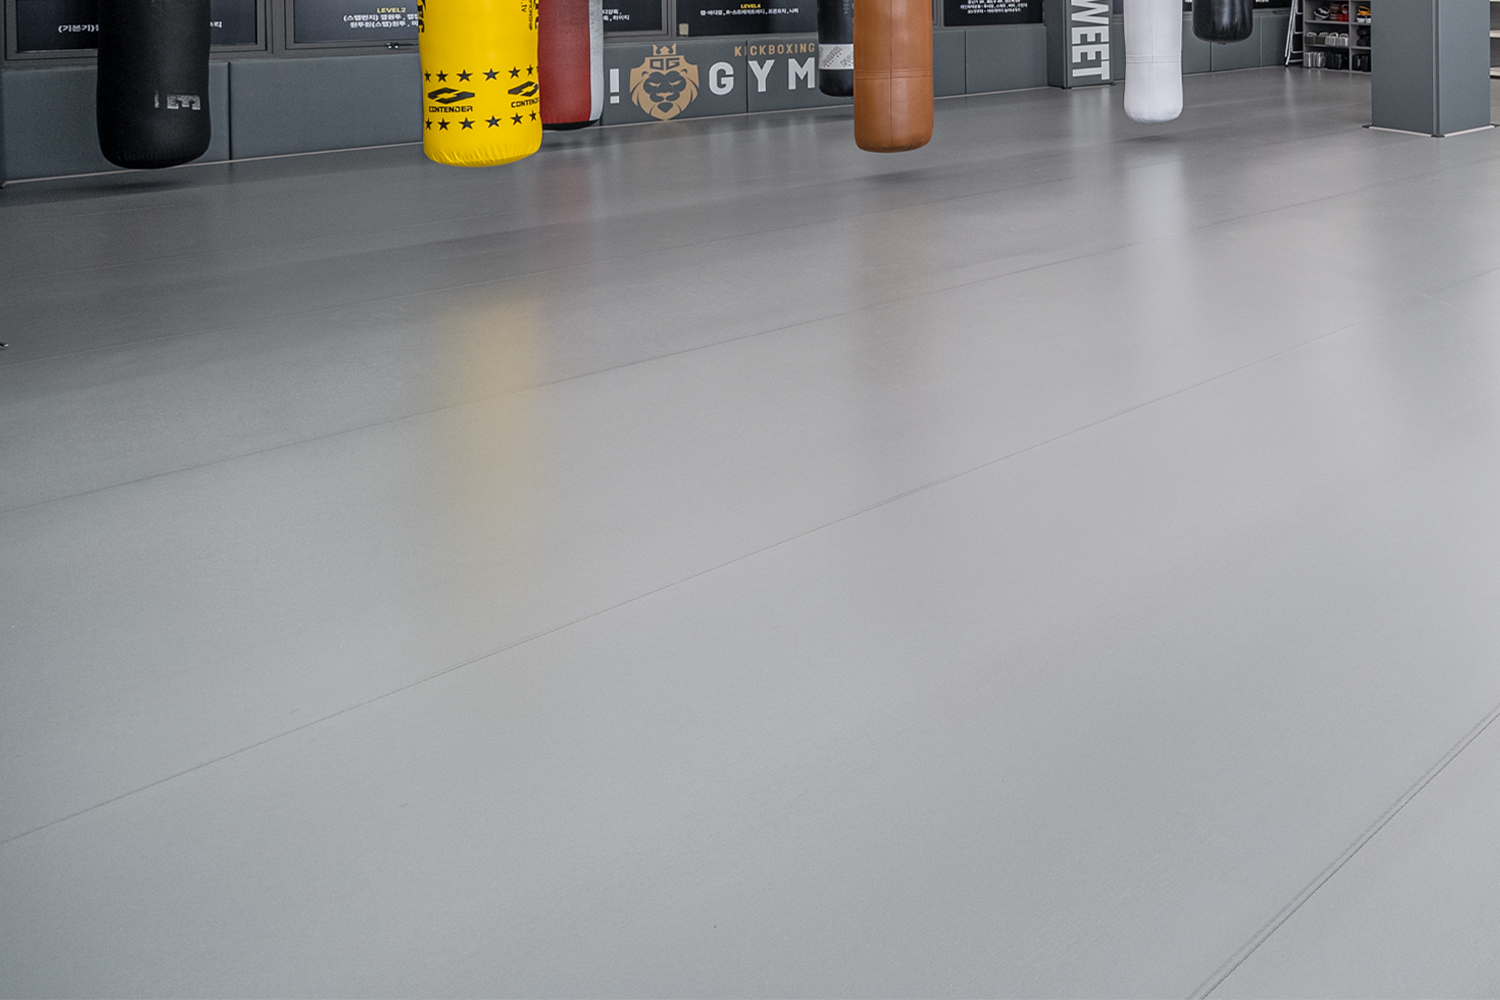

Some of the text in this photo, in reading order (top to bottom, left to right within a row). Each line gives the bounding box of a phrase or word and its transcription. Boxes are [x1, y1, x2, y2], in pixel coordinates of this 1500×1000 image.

[58, 24, 99, 34] (기본기)
[734, 42, 816, 57] KICKBOXING
[709, 57, 816, 96] GYM
[429, 105, 473, 113] CONTENDER
